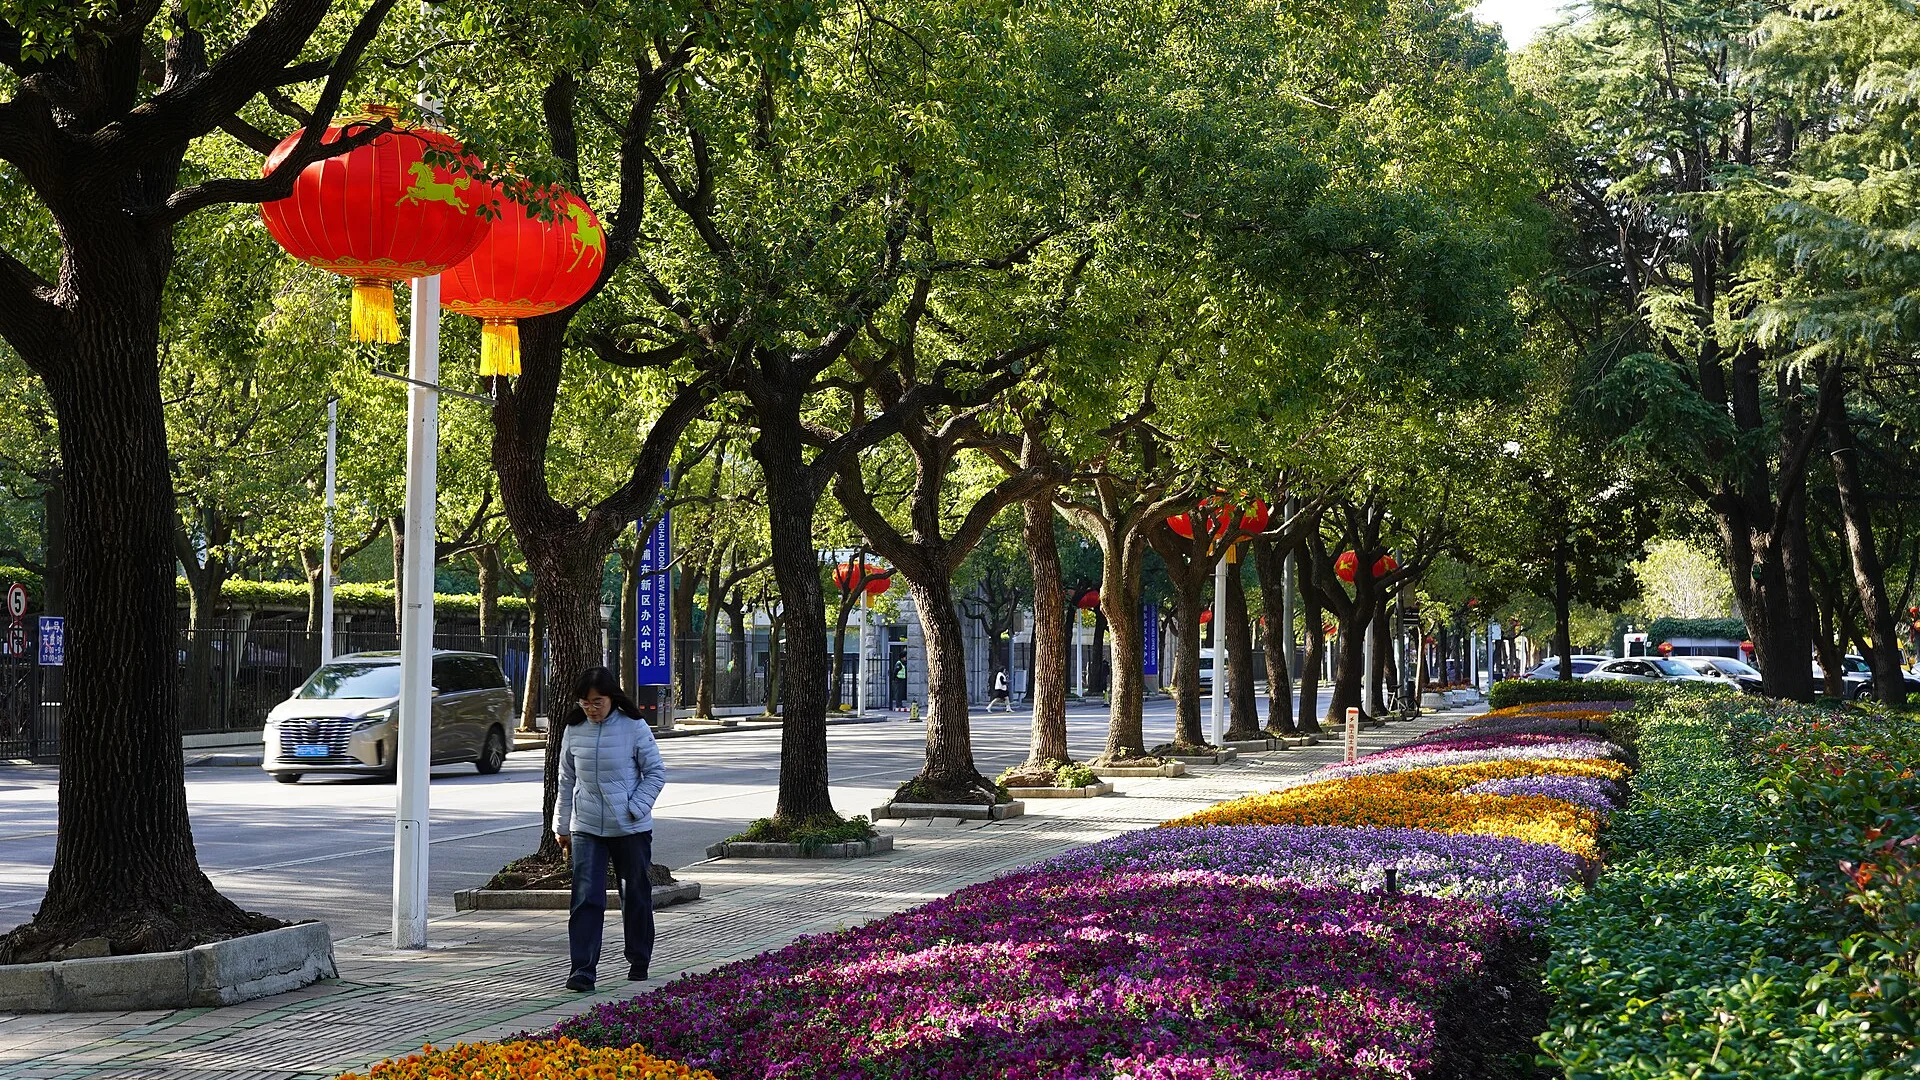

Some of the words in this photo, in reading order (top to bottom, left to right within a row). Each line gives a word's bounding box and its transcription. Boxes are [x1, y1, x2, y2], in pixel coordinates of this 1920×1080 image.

[15, 592, 21, 613] 5
[641, 535, 651, 667] 浦东新区办公中心
